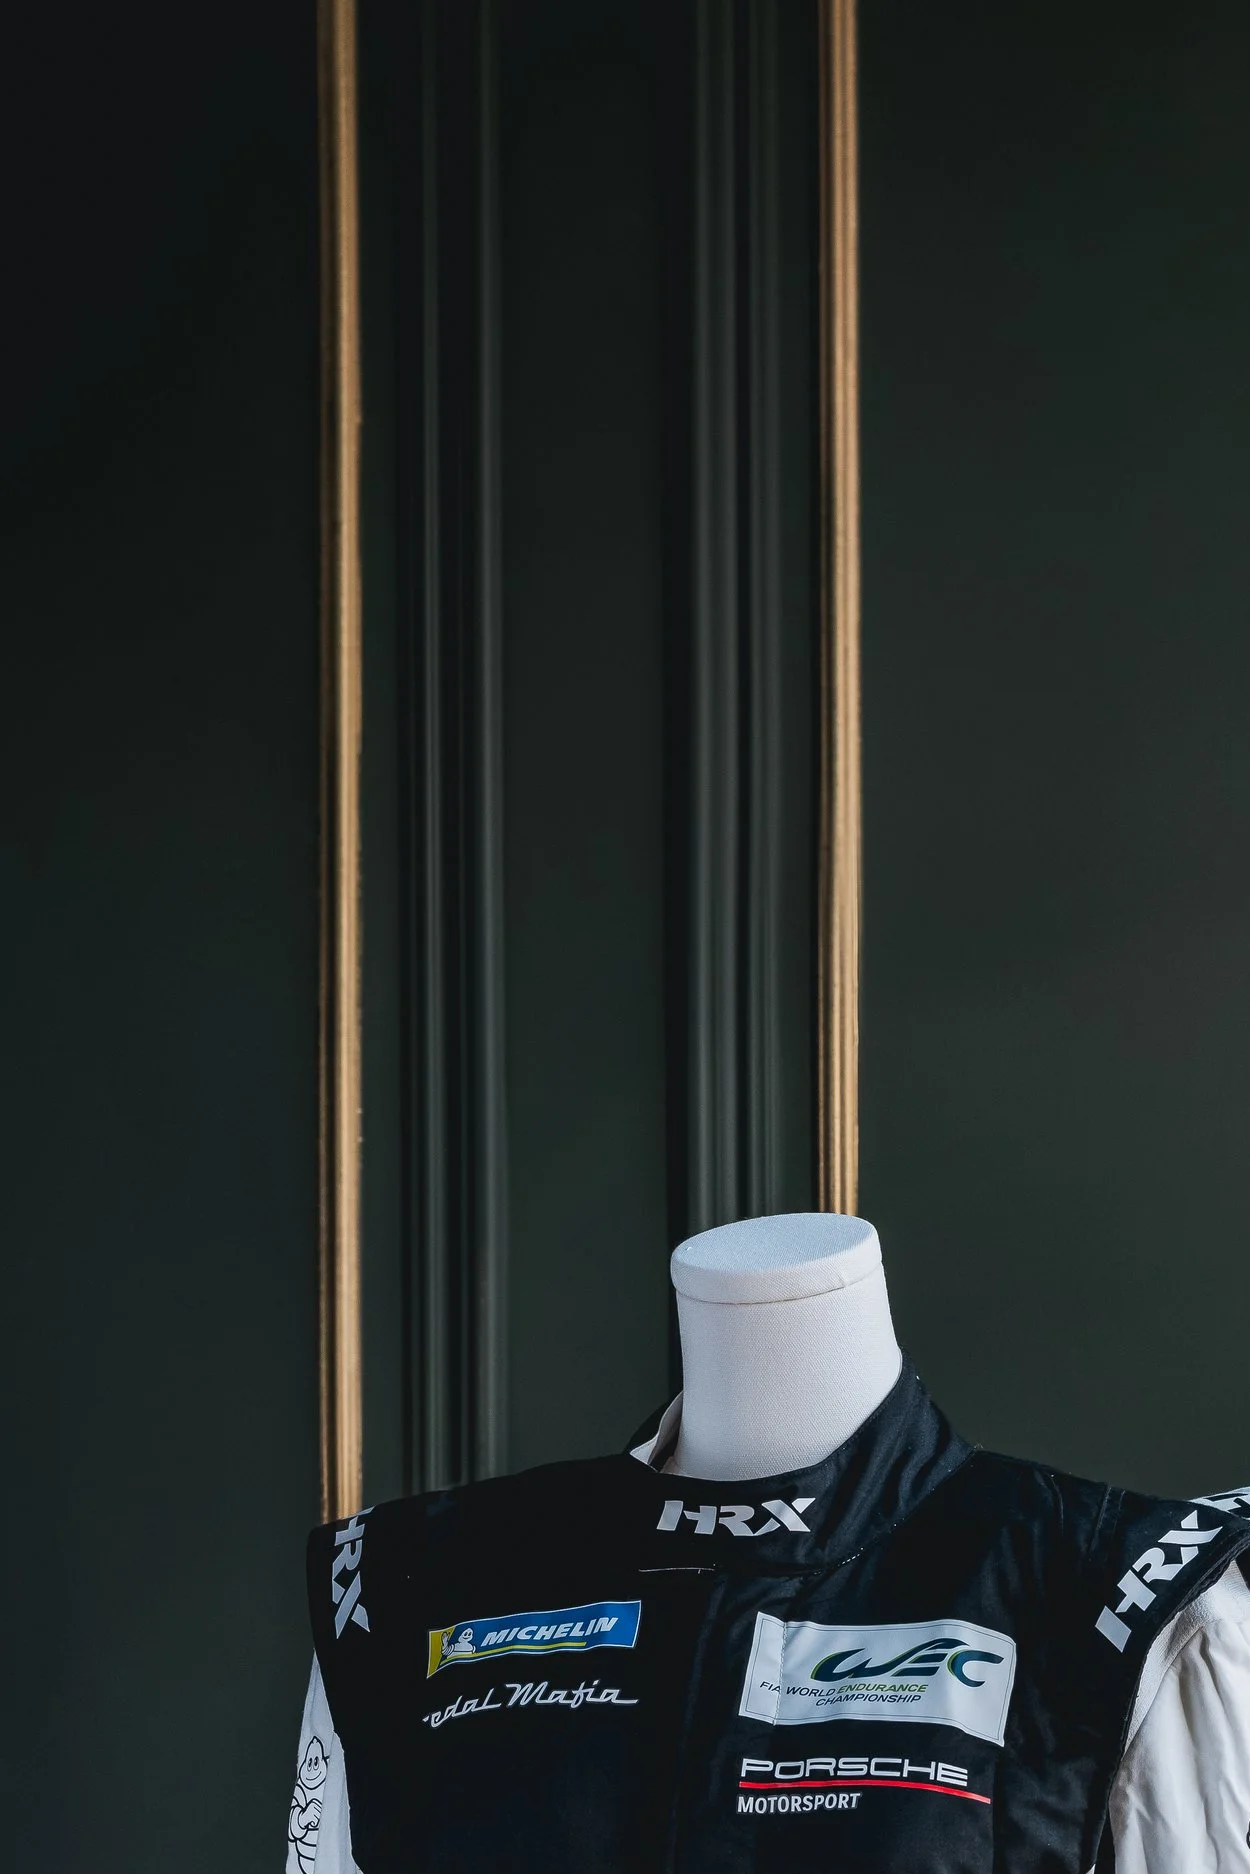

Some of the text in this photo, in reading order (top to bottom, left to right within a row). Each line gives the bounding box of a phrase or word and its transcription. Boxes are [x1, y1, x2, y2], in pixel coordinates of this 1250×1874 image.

[656, 1498, 816, 1536] HRX
[332, 1505, 375, 1639] HRX
[1095, 1510, 1223, 1653] HRX
[481, 1616, 618, 1647] MICHELIN
[810, 1638, 1004, 1688] WEC
[423, 1680, 638, 1727] edal Mafia
[760, 1681, 929, 1697] FIA WORLD ENDURANCE
[815, 1694, 922, 1707] CHAMPIONSHIP
[741, 1757, 968, 1787] PORSCHE
[738, 1793, 861, 1814] MOTORSPORT
